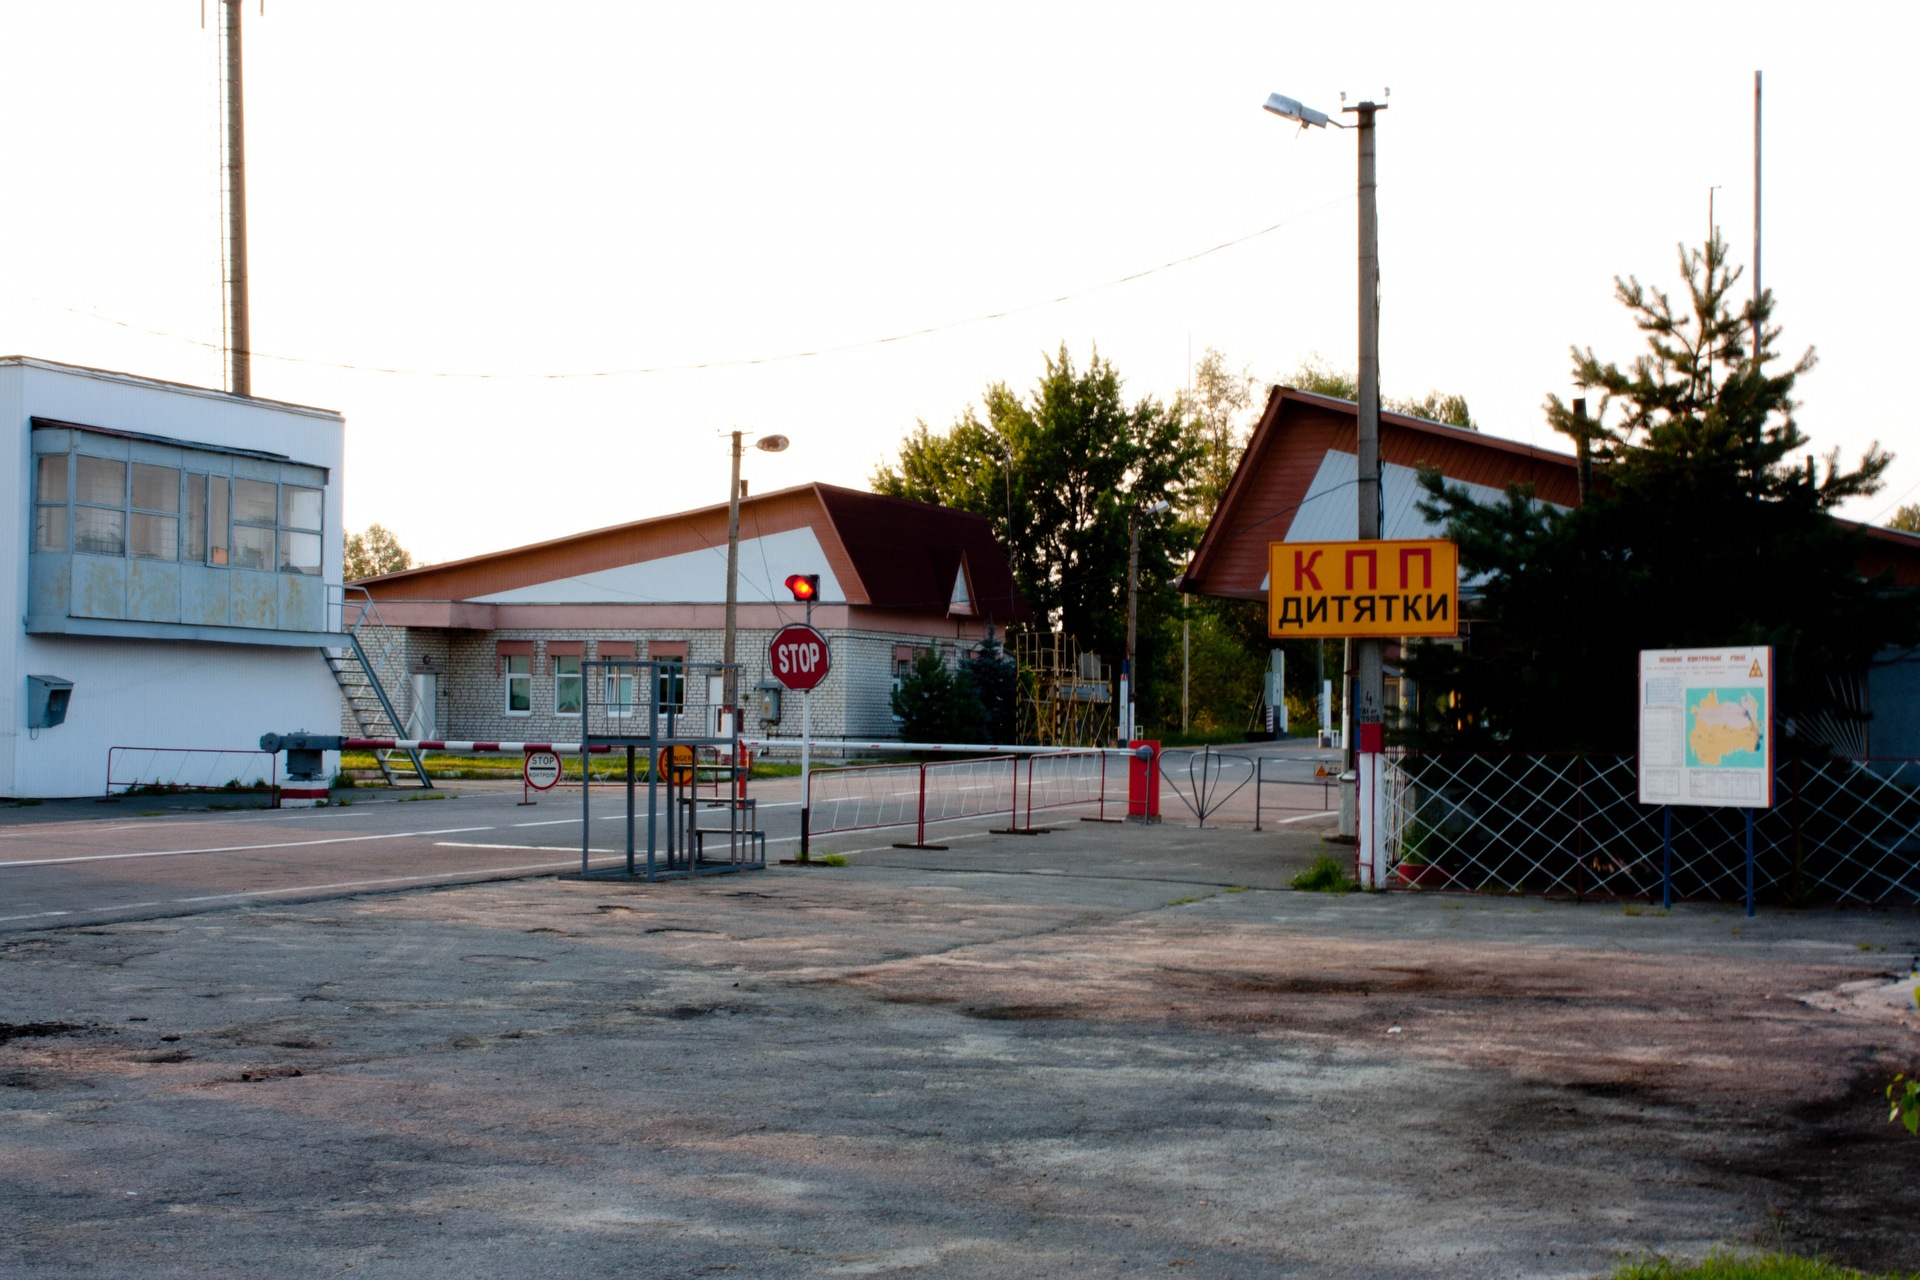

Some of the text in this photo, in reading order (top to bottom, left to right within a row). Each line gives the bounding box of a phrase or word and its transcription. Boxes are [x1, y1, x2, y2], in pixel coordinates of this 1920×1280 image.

[1294, 547, 1432, 591] КПП
[1278, 593, 1448, 629] ДИТЯТКИ
[778, 642, 820, 674] STOP
[532, 756, 555, 765] STOP
